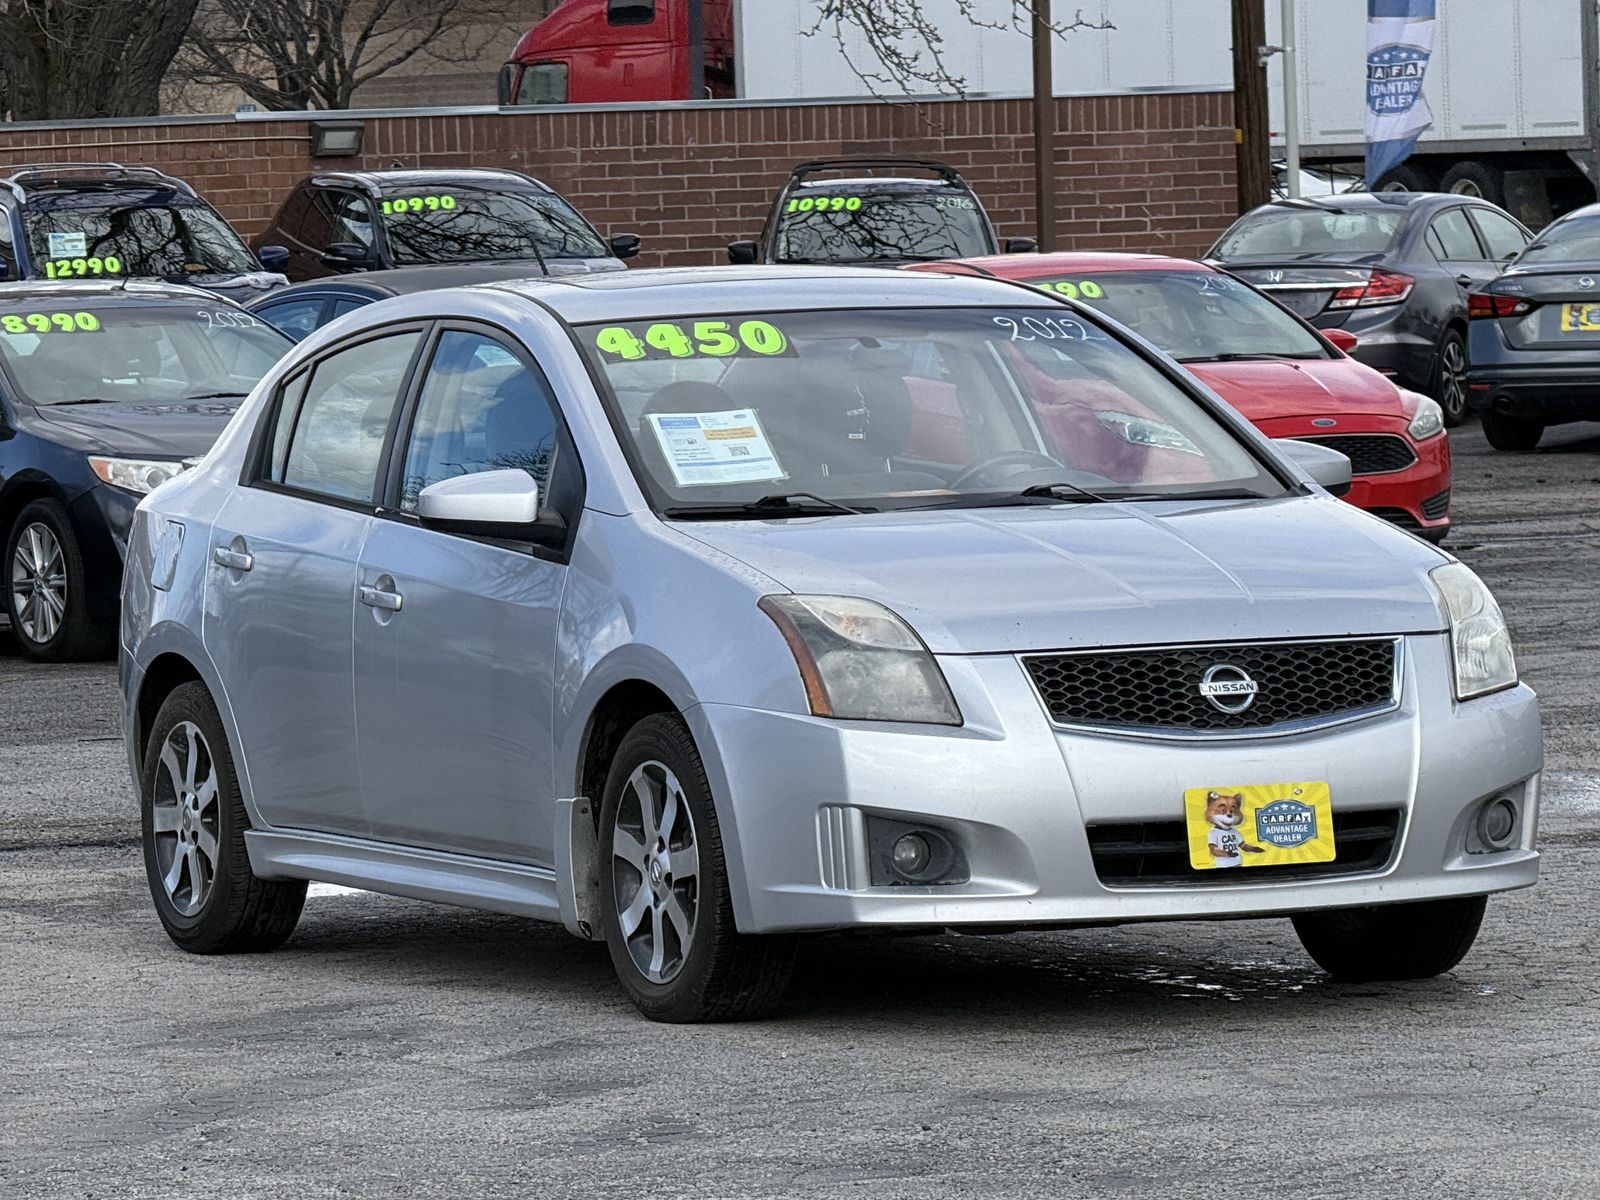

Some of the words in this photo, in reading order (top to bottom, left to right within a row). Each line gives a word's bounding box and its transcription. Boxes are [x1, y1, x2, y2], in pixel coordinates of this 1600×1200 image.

[383, 196, 457, 214] 10990
[788, 198, 862, 212] 10990
[46, 256, 121, 278] 12990
[1, 311, 100, 333] 8990
[197, 310, 266, 329] 2012
[992, 316, 1107, 342] 2012
[596, 320, 788, 360] 4450
[1208, 683, 1255, 693] NISSAN
[1261, 812, 1312, 825] CARFAX
[1265, 824, 1309, 835] ADVANTAGE
[1221, 834, 1237, 844] CAR
[1273, 834, 1302, 843] DEALER
[1222, 843, 1238, 852] FOX
